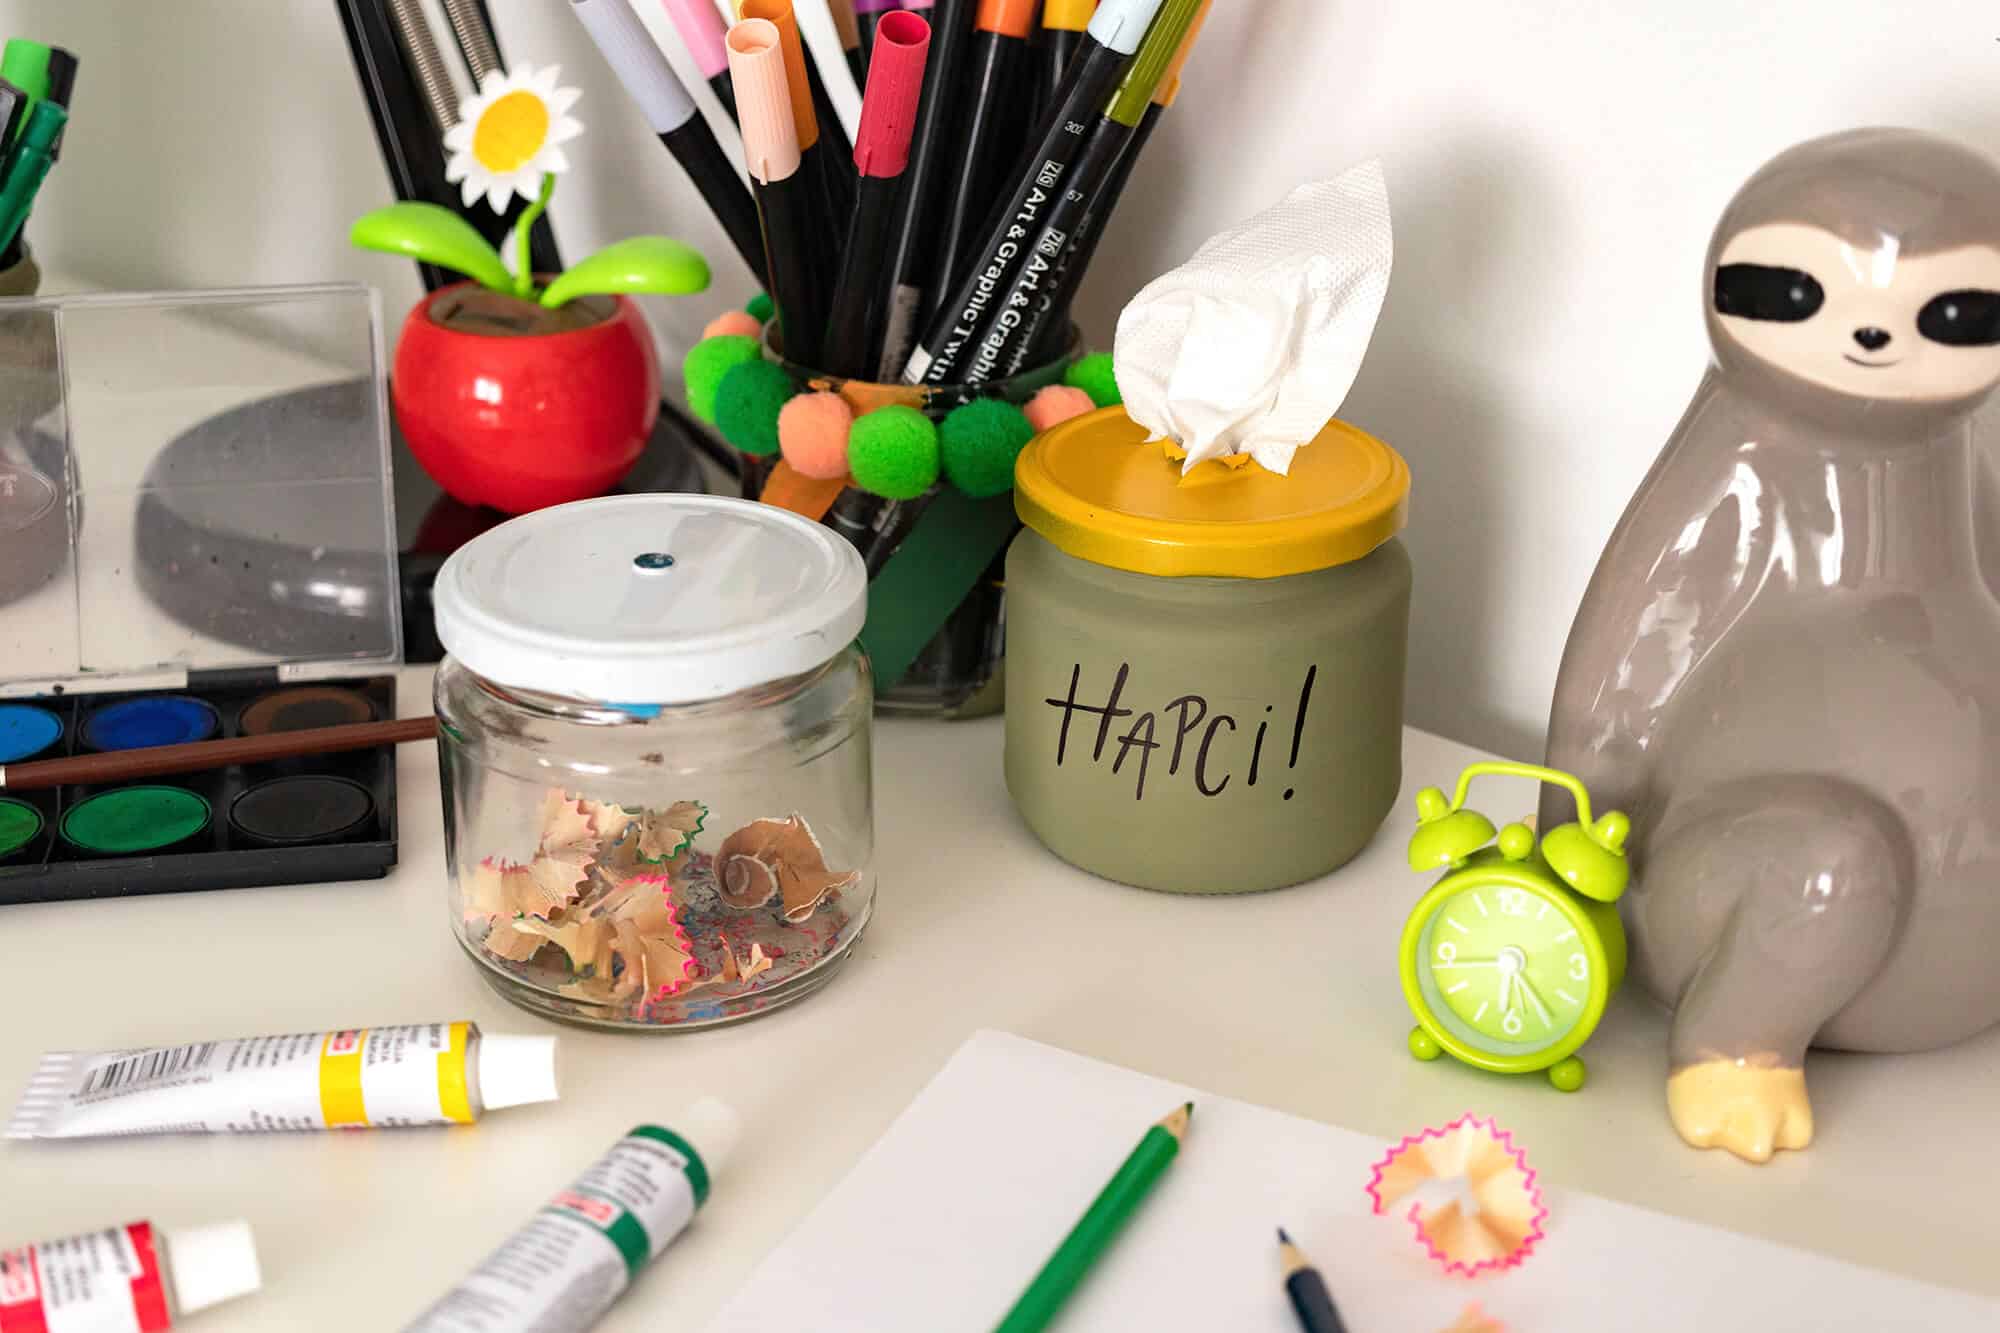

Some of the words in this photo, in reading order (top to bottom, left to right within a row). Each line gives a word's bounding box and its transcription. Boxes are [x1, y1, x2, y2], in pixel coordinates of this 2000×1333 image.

[1036, 160, 1064, 188] ZIG
[1017, 187, 1046, 222] Art
[1007, 224, 1027, 239] &
[1038, 227, 1066, 257] ZIG
[963, 242, 1018, 323] Graphic
[1019, 254, 1049, 291] Art
[1009, 292, 1029, 307] &
[928, 325, 975, 380] Twin
[1437, 941, 1457, 968] 9
[1568, 953, 1588, 981] 3
[1503, 1008, 1522, 1035] 6
